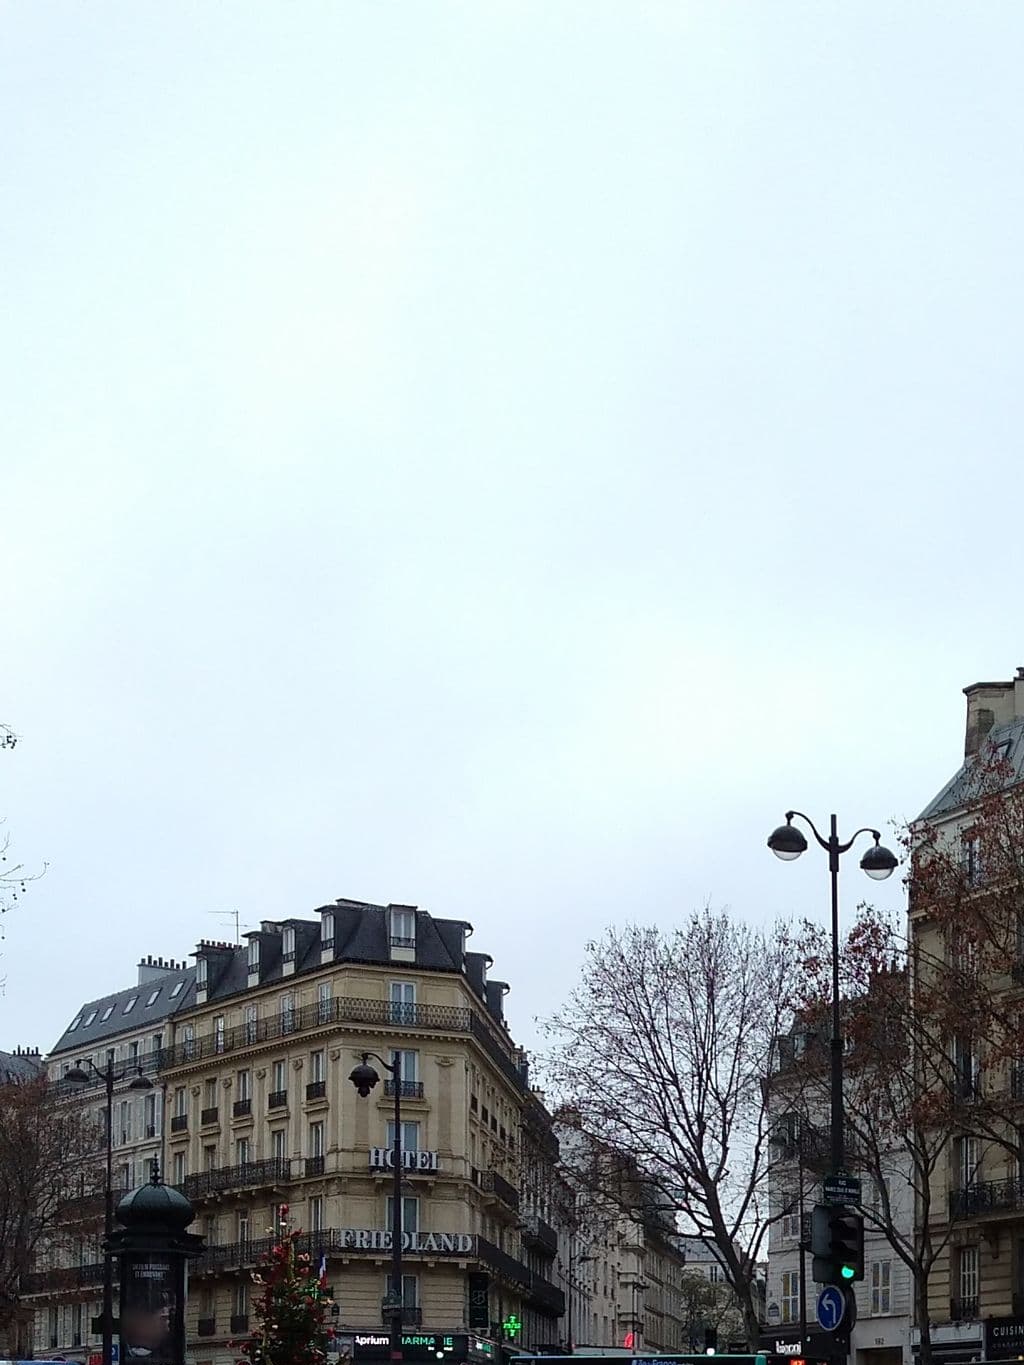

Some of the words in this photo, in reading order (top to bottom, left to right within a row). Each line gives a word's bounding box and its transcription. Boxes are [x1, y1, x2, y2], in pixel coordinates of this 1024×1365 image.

[369, 1148, 443, 1170] HOTEL
[340, 1230, 473, 1253] FRIEDLAND
[355, 1335, 390, 1346] Aprium
